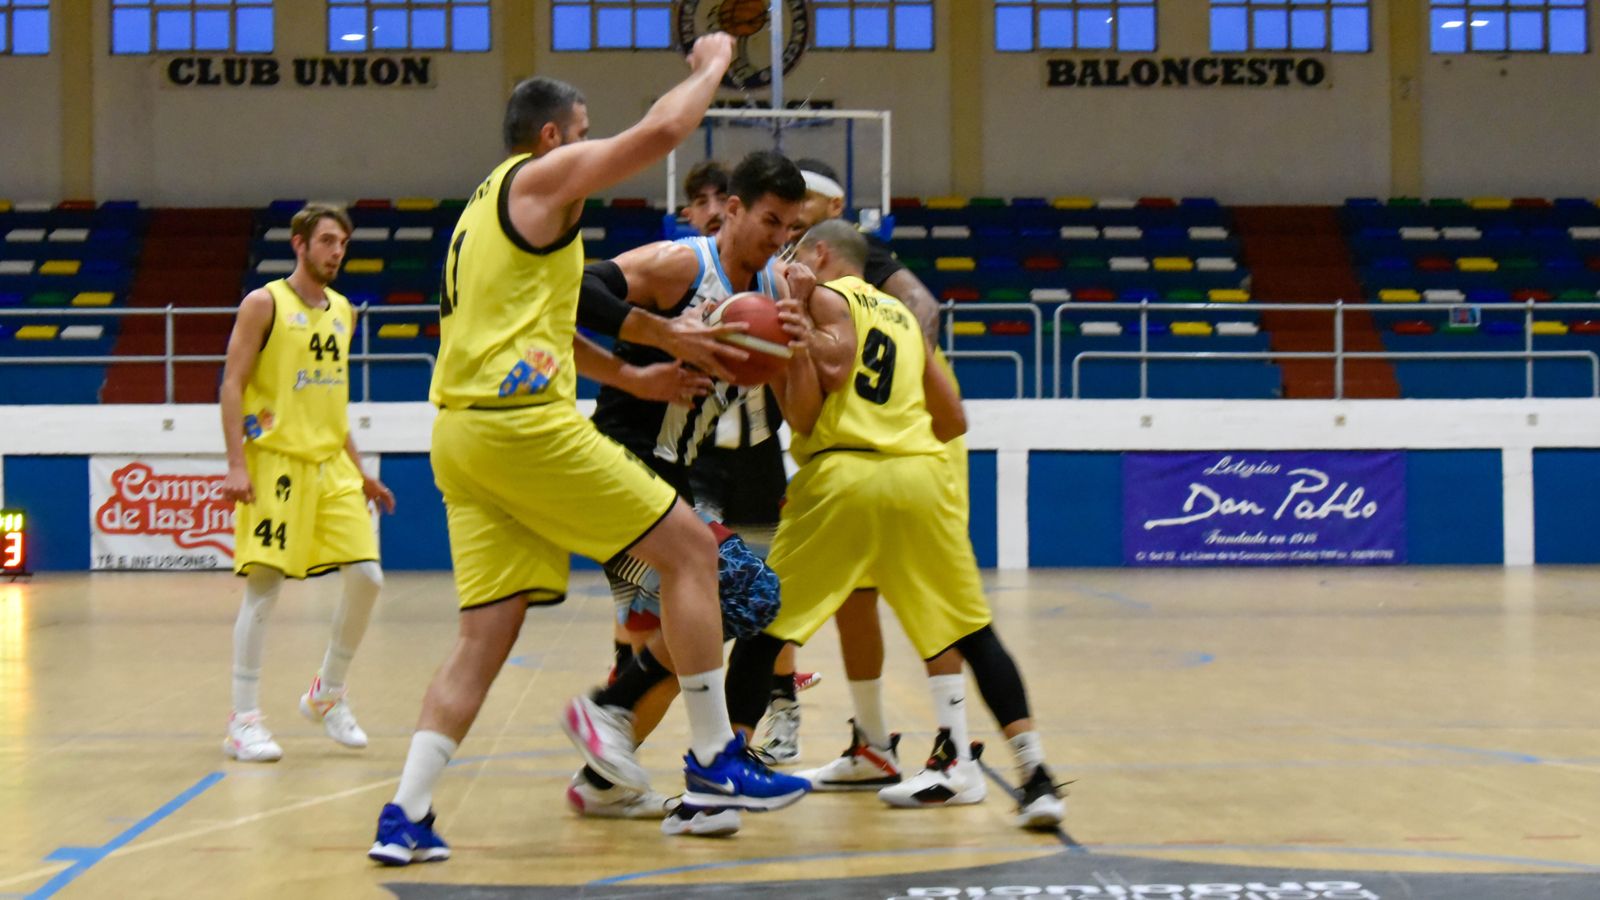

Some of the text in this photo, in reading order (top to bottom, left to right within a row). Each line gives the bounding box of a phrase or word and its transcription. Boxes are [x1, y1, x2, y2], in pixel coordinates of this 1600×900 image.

[168, 57, 431, 86] CLUB UNION
[1047, 57, 1325, 87] BALONCESTO
[309, 332, 340, 362] 44
[854, 327, 897, 405] 9
[118, 468, 226, 507] Compa
[1144, 468, 1378, 530] Don Pablo
[101, 502, 236, 538] de las In
[254, 518, 287, 551] 44
[1205, 529, 1267, 544] Fundada
[1269, 534, 1286, 544] en
[131, 555, 218, 568] INFUSIONES
